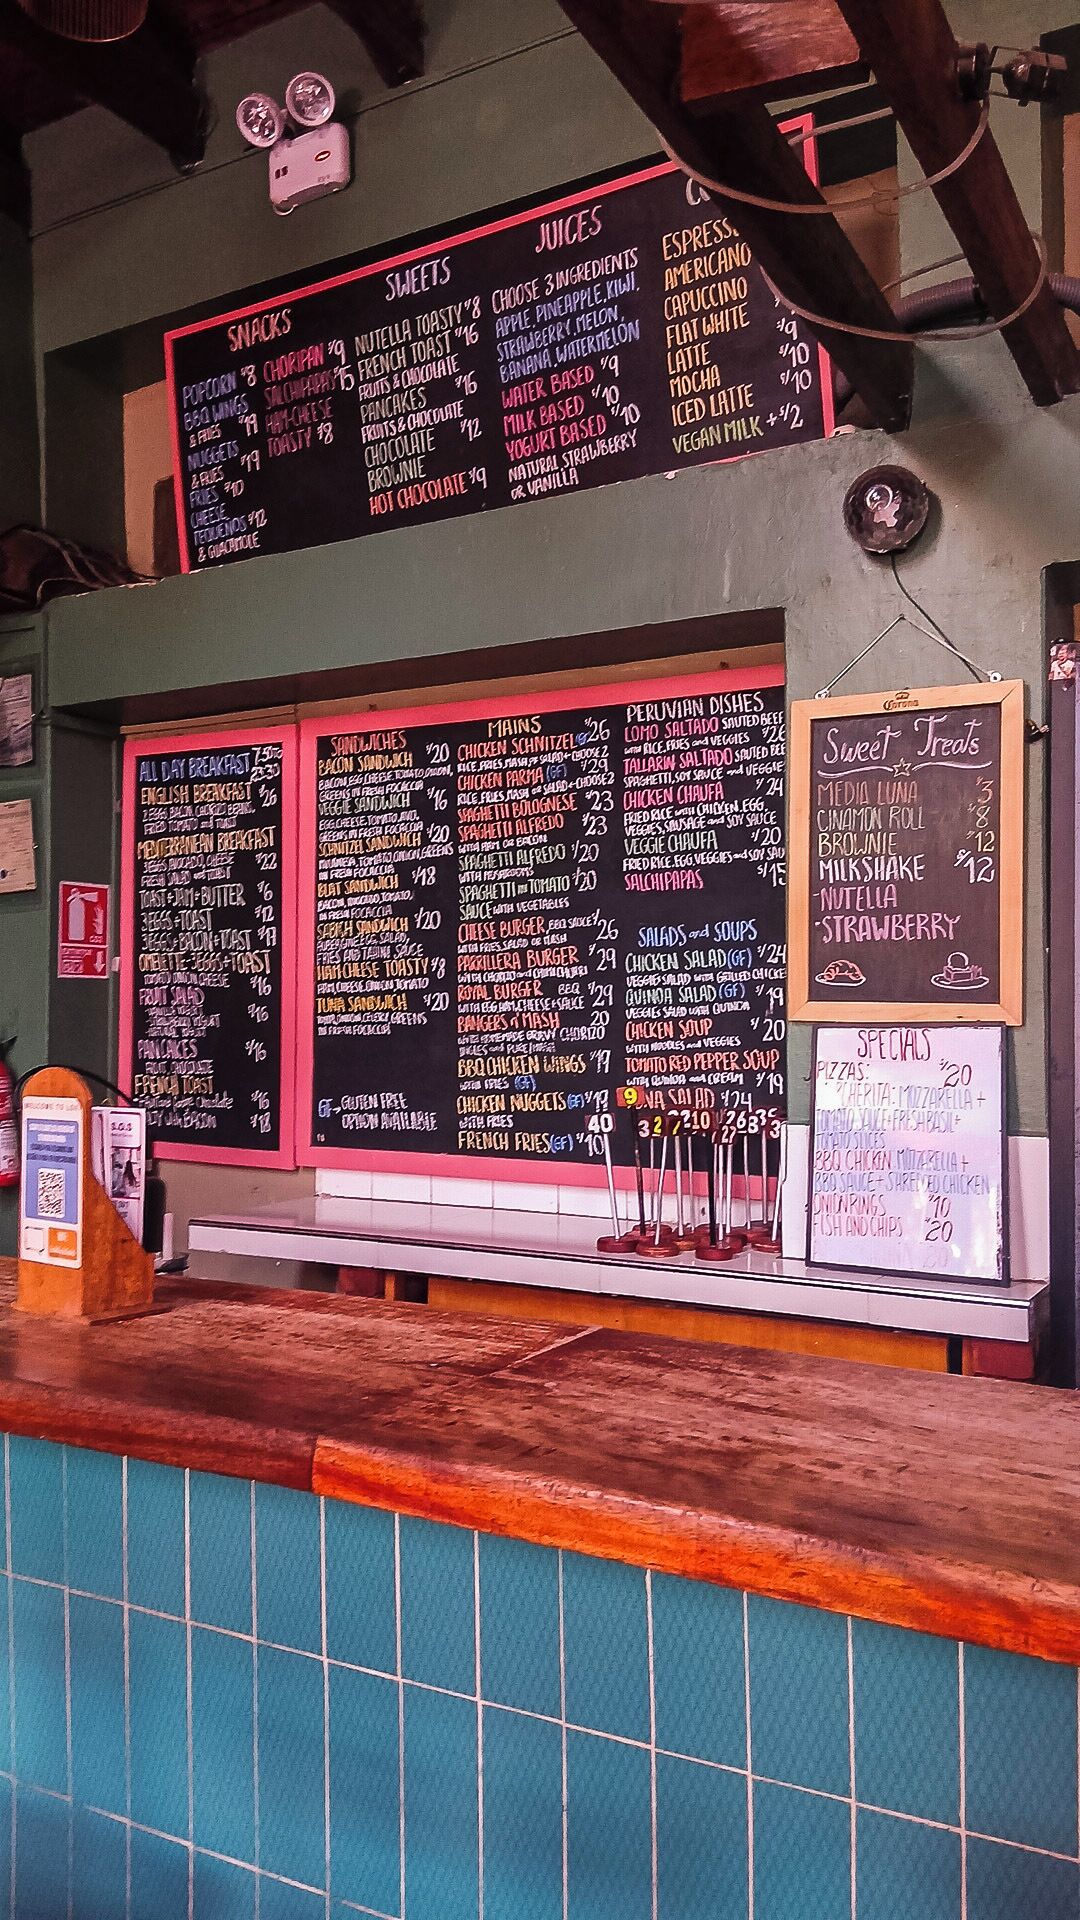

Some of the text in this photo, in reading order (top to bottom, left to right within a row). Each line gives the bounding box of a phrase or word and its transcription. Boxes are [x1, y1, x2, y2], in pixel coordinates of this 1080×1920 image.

[534, 205, 603, 254] JUICES
[385, 256, 453, 301] SWEETS
[491, 247, 640, 315] CHOOSE 3 INGREDIENTS
[664, 242, 752, 292] AMERICANO
[663, 277, 748, 320] CAPUCCINO
[228, 308, 292, 352] SNACKS
[354, 303, 464, 357] NUTELLA TOASTY
[665, 303, 750, 354] FLAT WHITE
[357, 330, 454, 383] FRENCH TOAST
[559, 320, 641, 370] WATERMELON
[263, 343, 325, 382] CHORIPAN
[666, 342, 711, 382] LATTE
[182, 371, 238, 408] POPCORN
[501, 379, 547, 409] WATER
[549, 364, 596, 395] BASED
[669, 365, 720, 398] MOCHA
[360, 386, 429, 424] PANCAKES
[502, 408, 538, 437] MILK
[539, 395, 586, 426] BASED
[671, 400, 707, 428] ICED
[709, 384, 753, 417] LATTE
[267, 428, 312, 458] TOASTY
[364, 428, 438, 468] CHOCOLATE
[505, 427, 556, 463] YOGURT
[558, 413, 608, 445] BASED
[672, 404, 765, 462] VEGAN MILK
[562, 430, 638, 472] STRAWBERRY
[367, 455, 427, 492] BROWNIE
[526, 466, 580, 496] VANILLA
[369, 471, 469, 516] HOT CHOCOLATE
[627, 691, 765, 723] PERUVIAN DISHES
[882, 698, 919, 711] Corona
[488, 716, 541, 738] MAINS
[624, 723, 659, 743] LOMO
[664, 716, 720, 739] SALTADO
[822, 714, 983, 765] Sweet Treats
[330, 730, 408, 757] SANDWICHES
[457, 739, 507, 762] CHICKEN
[511, 733, 577, 756] SCHNITZEL
[357, 751, 413, 773] SANDWICH
[623, 747, 734, 776] TALLARIN SALTADO
[457, 767, 544, 792] CHICKEN PARMA
[815, 779, 919, 808] MEDIA LUNA
[354, 792, 411, 814] SANDWICH
[457, 793, 578, 823] SPAGHETTI BOLOGNESE
[624, 783, 674, 811] CHICKEN
[677, 780, 726, 805] CHAUFA
[457, 813, 565, 844] SPAGHETTI ALFREDO
[816, 804, 926, 832] CINAMON ROLL
[366, 831, 422, 854] SANDWICH
[459, 849, 513, 872] SPAGHETTI
[516, 843, 566, 866] ALFREDO
[624, 836, 666, 857] VEGGIE
[667, 828, 719, 852] CHAUFA
[818, 832, 898, 858] BROWNIE
[624, 868, 705, 893] SALCHIPAPAS
[818, 854, 926, 884] MILKSHAKE
[458, 915, 545, 944] CHEESE BURGER
[637, 917, 758, 949] SALADS and SOUPS
[383, 957, 429, 977] TOASTY
[526, 945, 579, 968] BURGER
[624, 951, 680, 974] CHICKEN
[683, 945, 728, 971] SALAD
[727, 946, 753, 970] (GF)
[457, 980, 544, 1003] ROYAL BURGER
[677, 982, 718, 1004] SALAD
[719, 981, 746, 1000] (GF)
[522, 1010, 560, 1030] MASH
[625, 1018, 674, 1042] CHICKEN
[678, 1017, 713, 1040] SOUP
[857, 1026, 932, 1062] SPECIALS
[457, 1055, 540, 1078] BBQ CHICKEN
[668, 1047, 781, 1073] RED PEPPER SOUP
[457, 1092, 567, 1115] CHICKEN NUGGETS
[623, 1087, 639, 1105] 9
[586, 1113, 615, 1134] 40
[457, 1130, 509, 1151] FRENCH
[515, 1132, 551, 1153] FRIES
[868, 1215, 905, 1240] CHIPS
